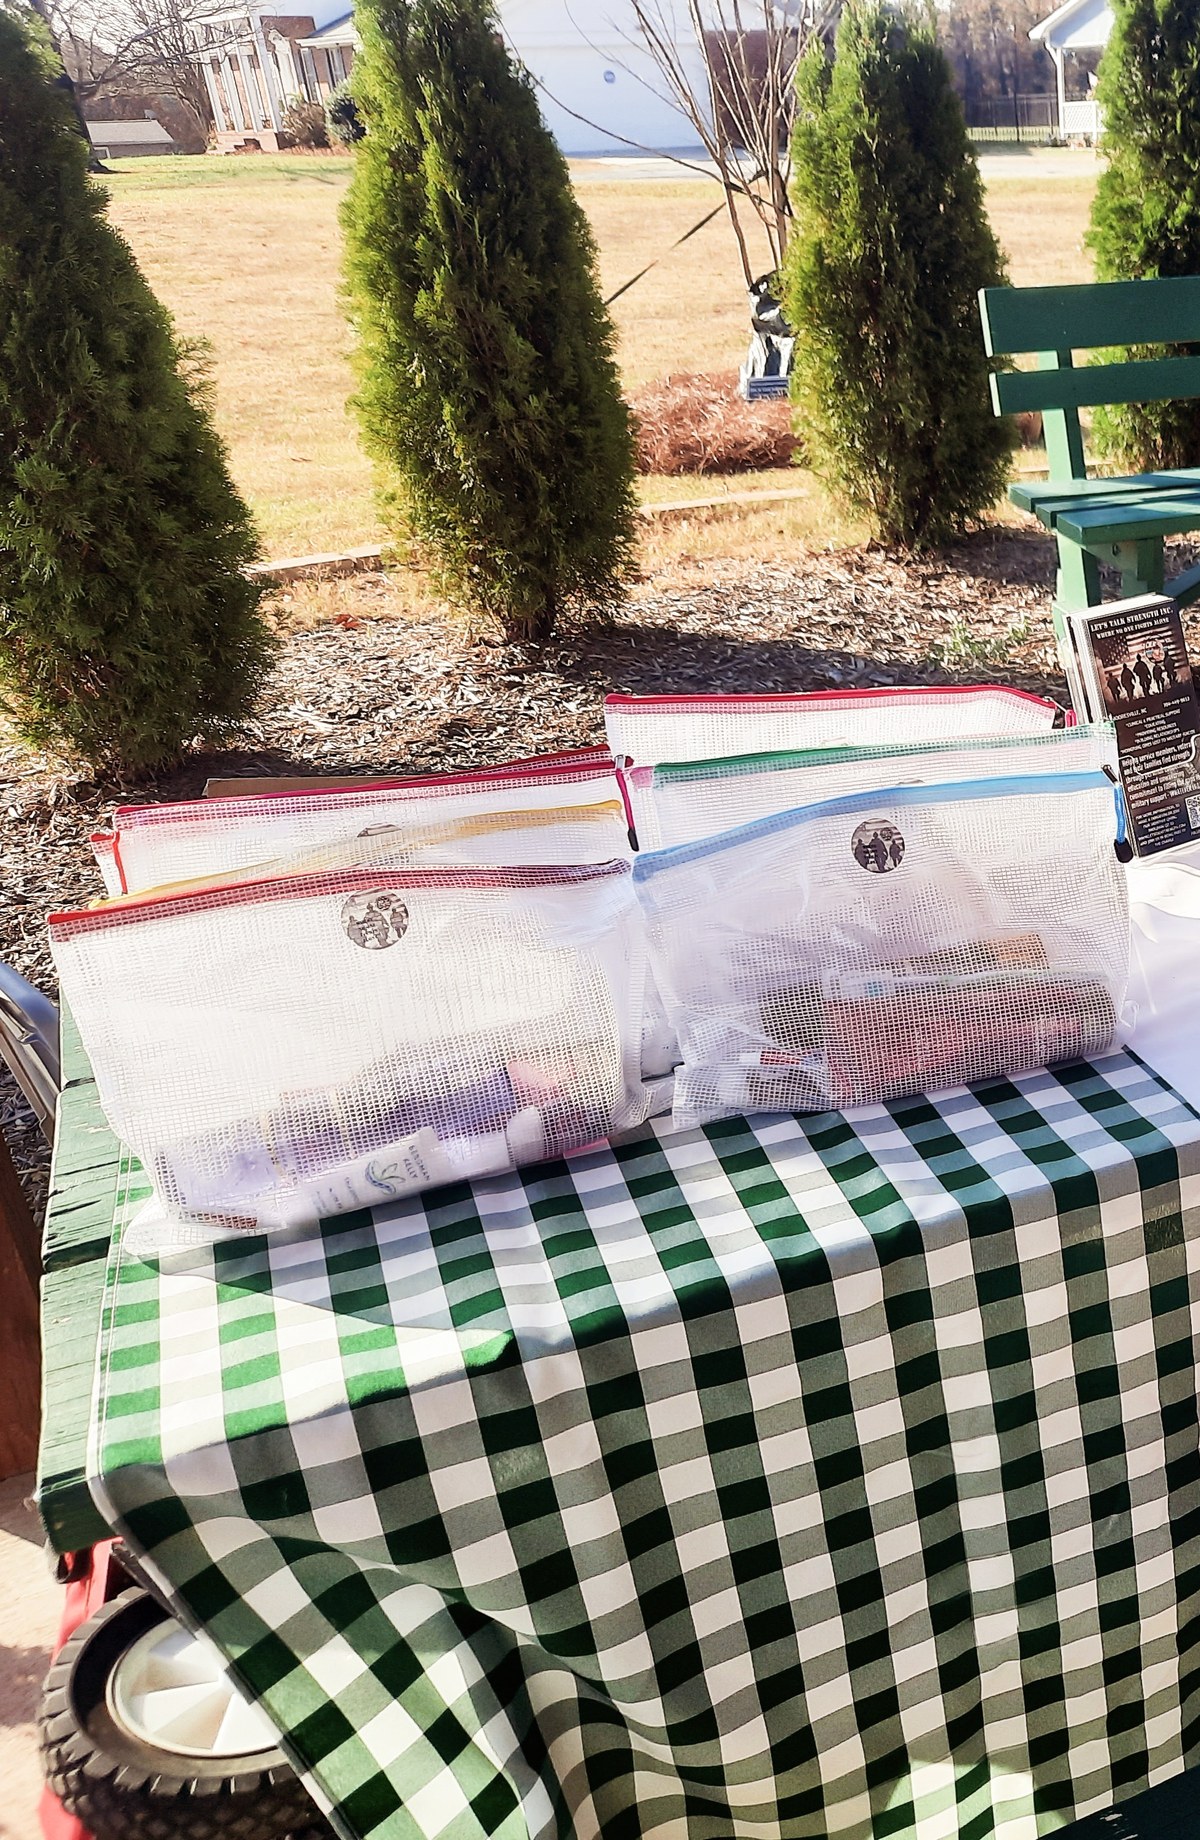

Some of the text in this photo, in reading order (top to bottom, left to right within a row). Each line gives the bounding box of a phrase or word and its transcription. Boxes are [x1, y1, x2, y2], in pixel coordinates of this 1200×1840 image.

[1090, 607, 1173, 632] LET'S TALK STRENGTH INC.
[1096, 630, 1117, 639] WHERE
[1135, 621, 1153, 630] FIGHTS
[1154, 617, 1169, 625] ALONE
